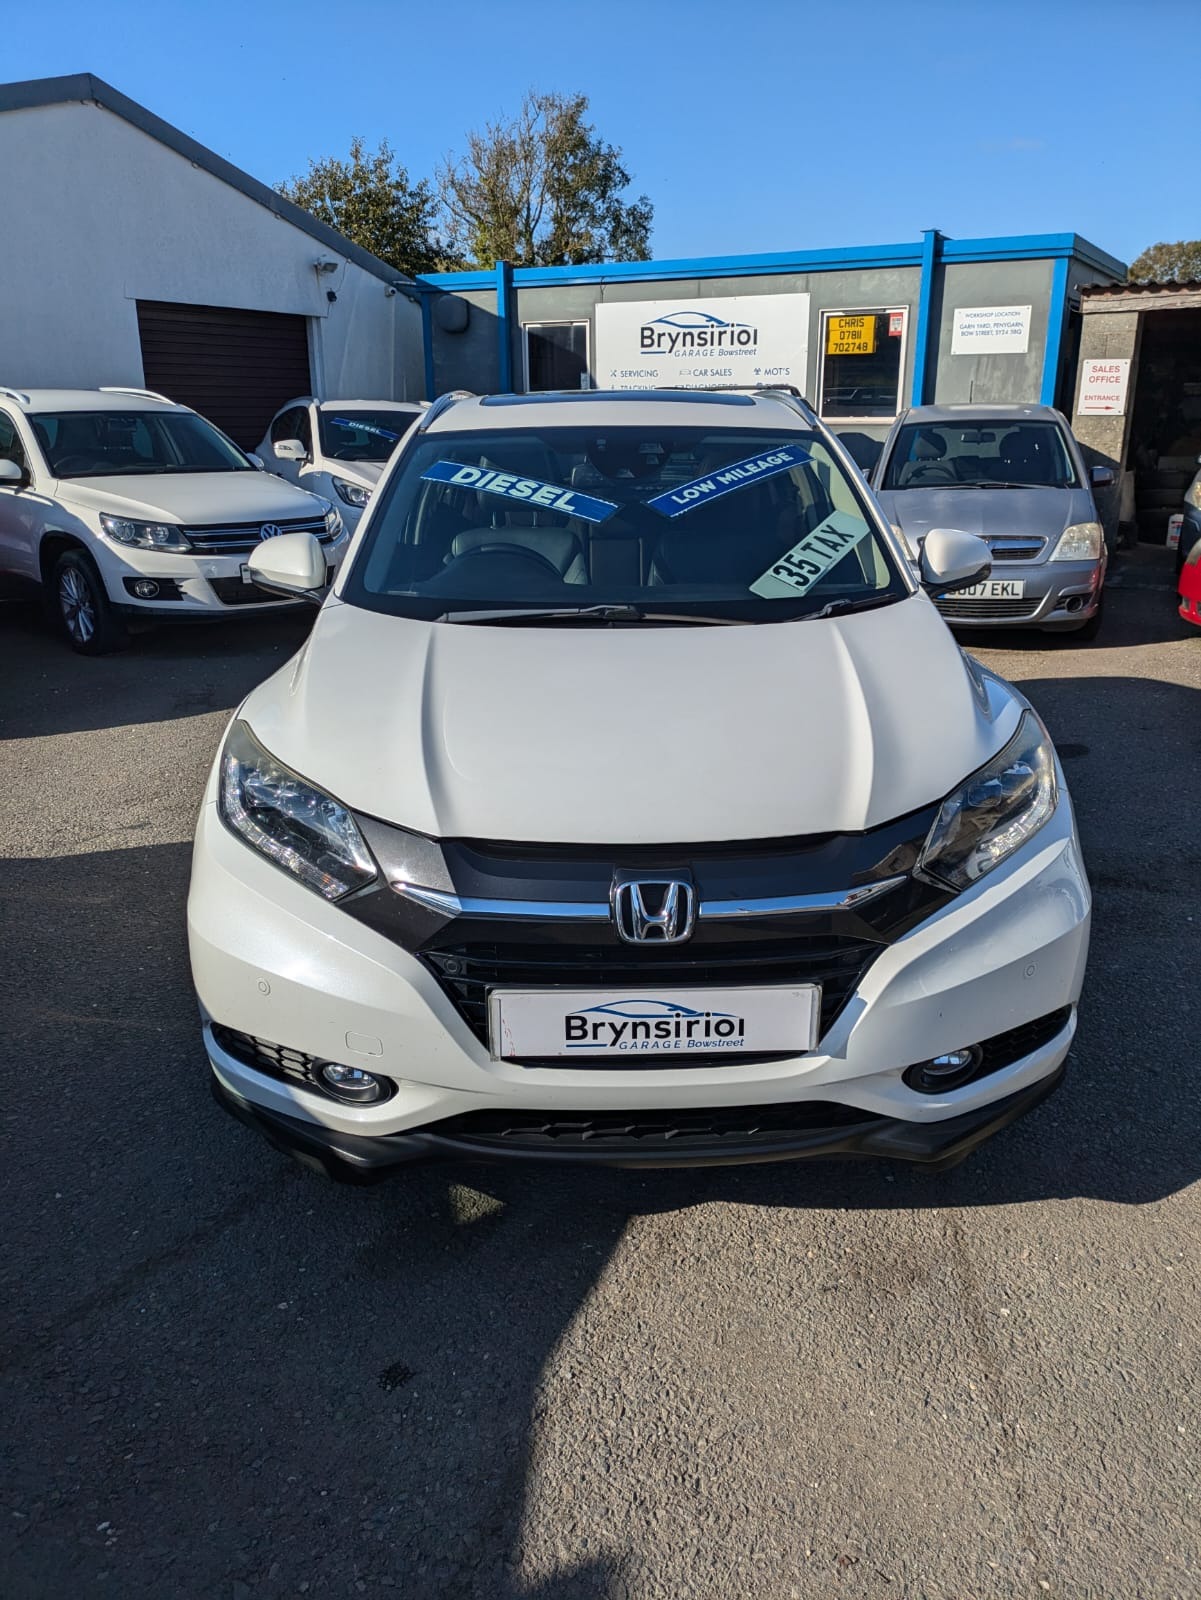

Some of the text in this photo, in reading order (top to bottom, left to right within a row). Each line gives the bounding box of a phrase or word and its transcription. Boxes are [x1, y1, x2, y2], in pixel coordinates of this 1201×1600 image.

[838, 318, 865, 328] CHRIS
[640, 324, 758, 354] Brynsiriol
[674, 348, 757, 358] GARAGE Bowstreet
[833, 342, 868, 352] 702748
[620, 369, 659, 378] SERVICING
[693, 368, 733, 376] CAR SALES
[764, 367, 791, 376] MOT'S
[1092, 365, 1121, 373] SALES
[348, 422, 381, 434] DIESEL
[671, 452, 794, 504] LOW MILEAGE
[451, 467, 576, 512] DIESEL
[772, 524, 855, 588] 35 TAX
[991, 582, 1020, 596] EKL
[565, 1012, 745, 1047] Brynsiriol
[619, 1038, 745, 1050] GARAGE Bowstreet
